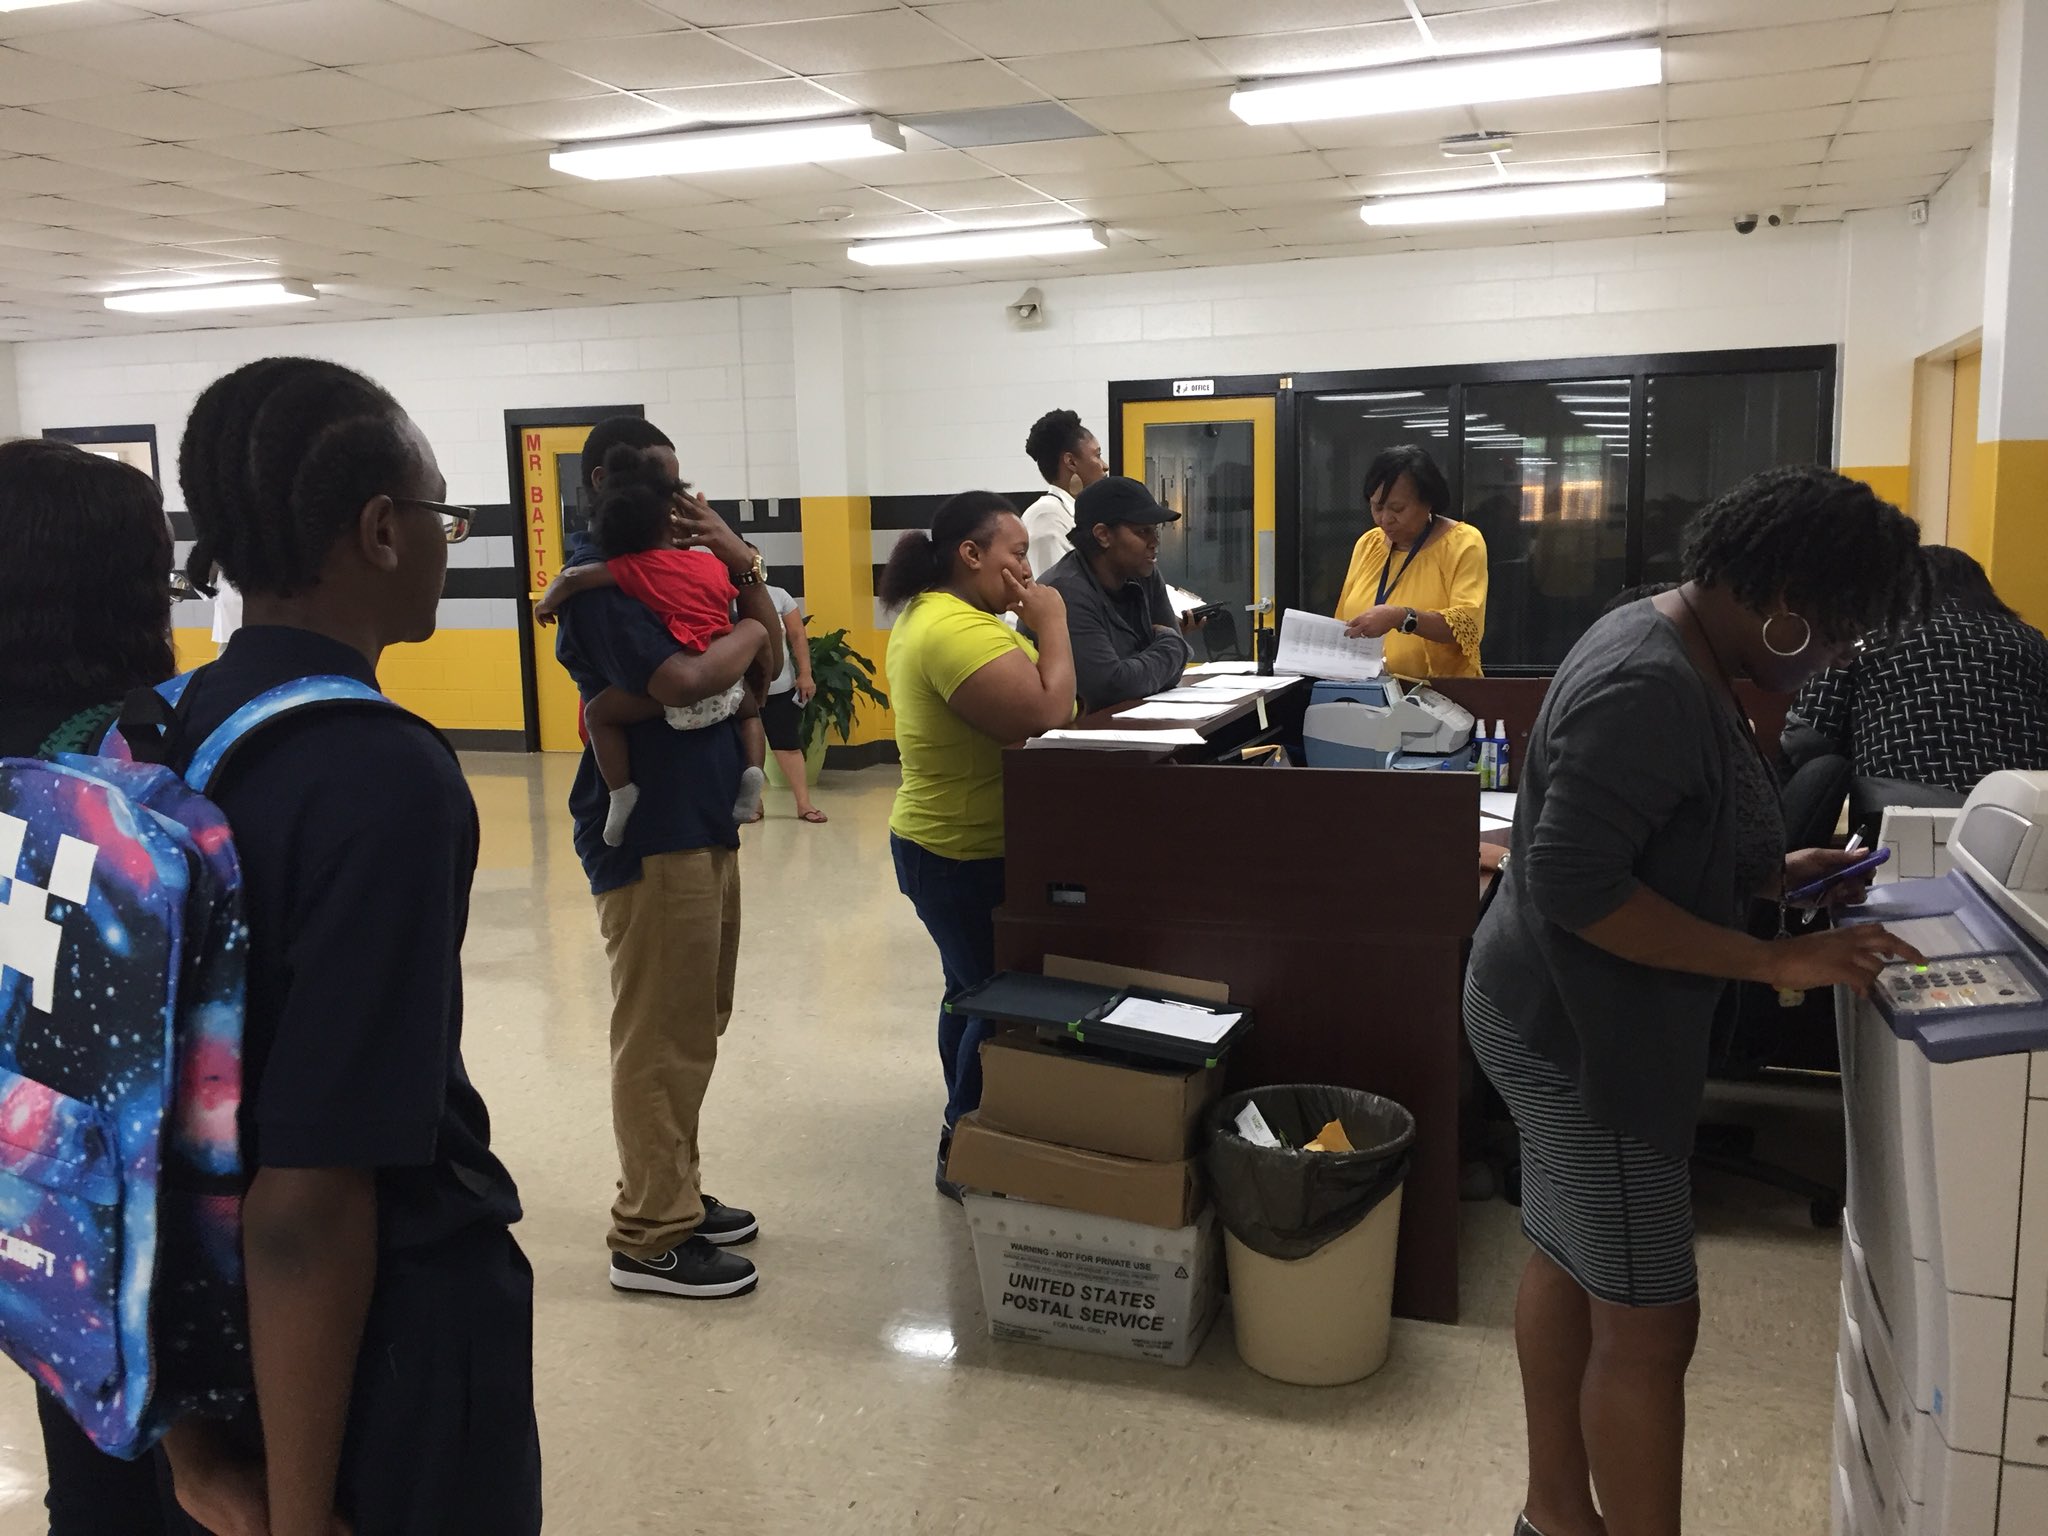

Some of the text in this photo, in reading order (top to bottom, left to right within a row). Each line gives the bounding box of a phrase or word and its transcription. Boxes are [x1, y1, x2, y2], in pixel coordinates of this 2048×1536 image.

[531, 486, 548, 588] BATTS
[1010, 1243, 1049, 1256] WARNING
[1056, 1250, 1074, 1259] NOT
[1076, 1253, 1094, 1263] FOR
[1095, 1256, 1131, 1269] PRIVATE
[1133, 1262, 1151, 1271] USE
[1008, 1272, 1075, 1297] UNITED
[1080, 1285, 1155, 1310] STATES
[1002, 1292, 1074, 1319] POSTAL
[1080, 1307, 1165, 1332] SERVICE
[1053, 1320, 1107, 1335] FOR MAIL ONLY
